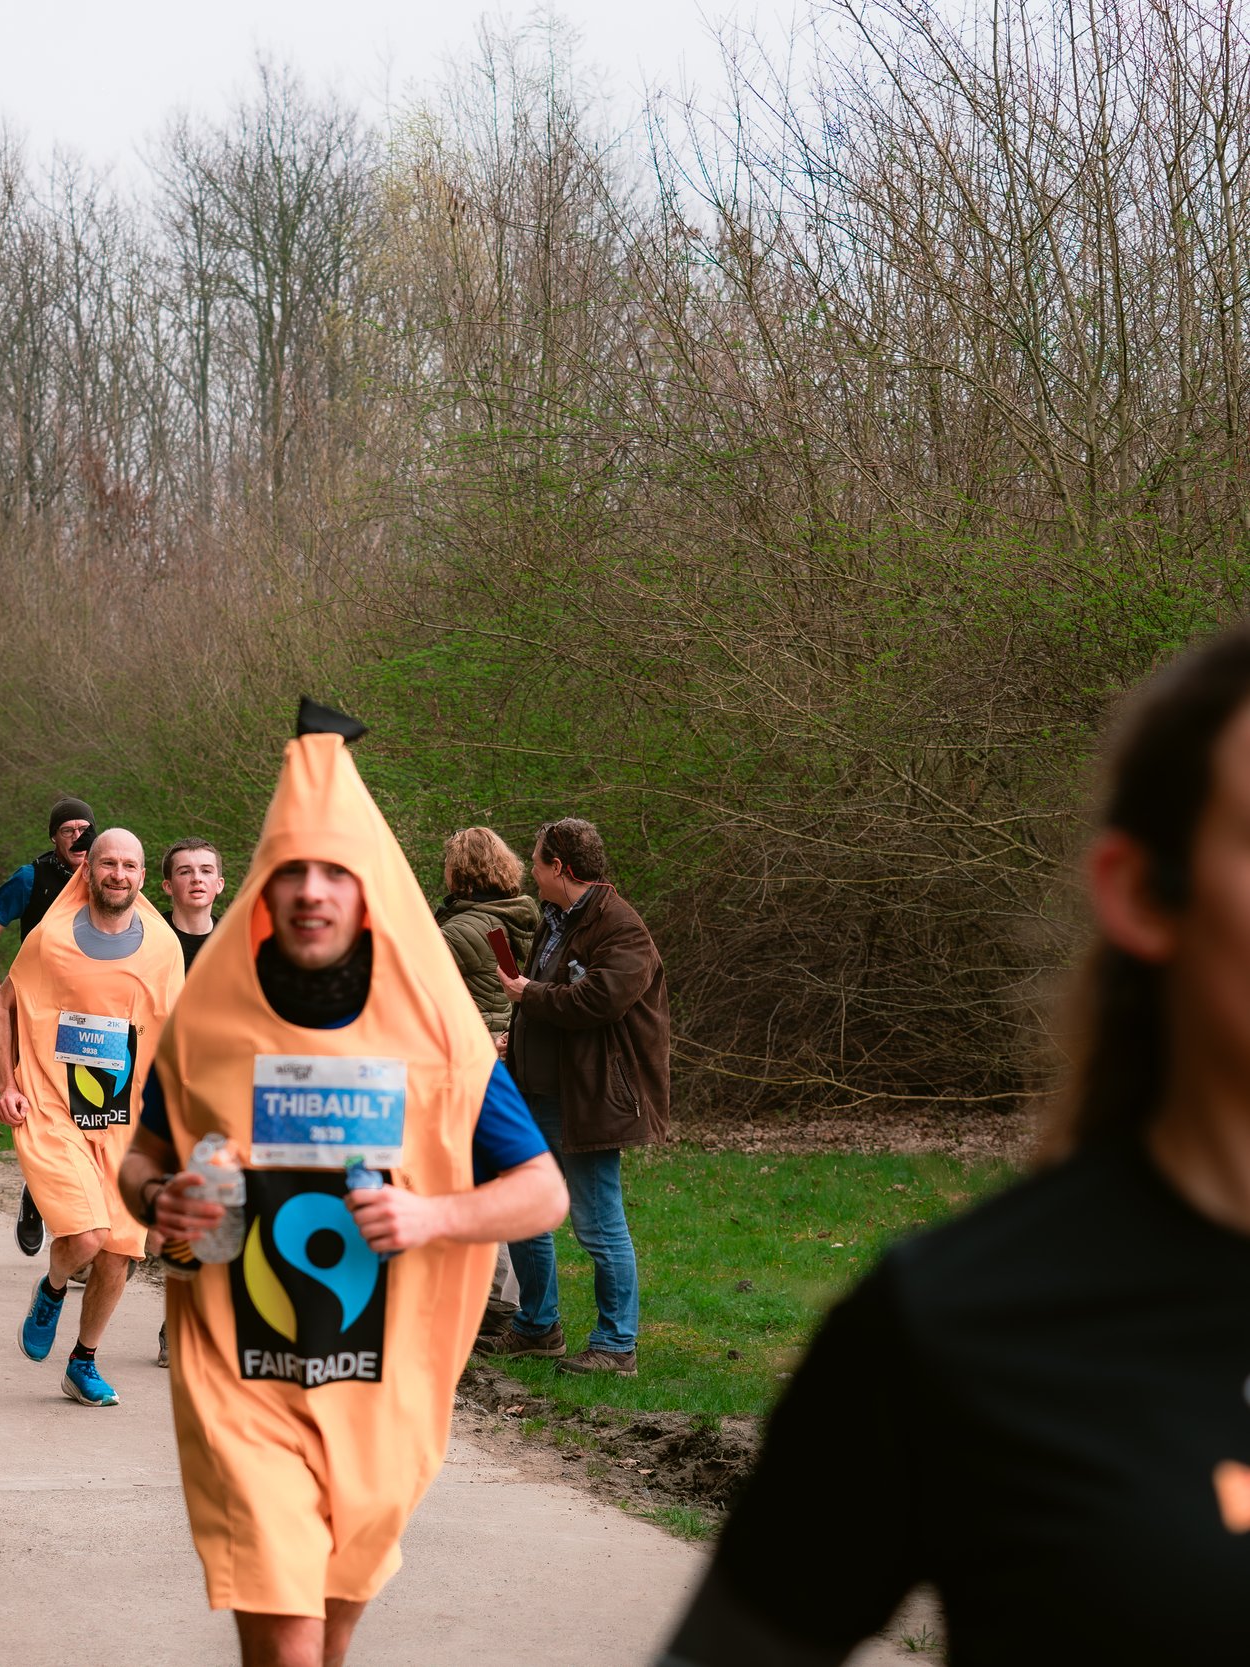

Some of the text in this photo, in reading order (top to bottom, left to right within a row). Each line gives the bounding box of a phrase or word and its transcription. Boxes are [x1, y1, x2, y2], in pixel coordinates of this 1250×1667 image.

[107, 1020, 120, 1028] 21K
[79, 1031, 104, 1045] WIM
[82, 1047, 98, 1055] 3938
[263, 1092, 396, 1119] THIBAULT
